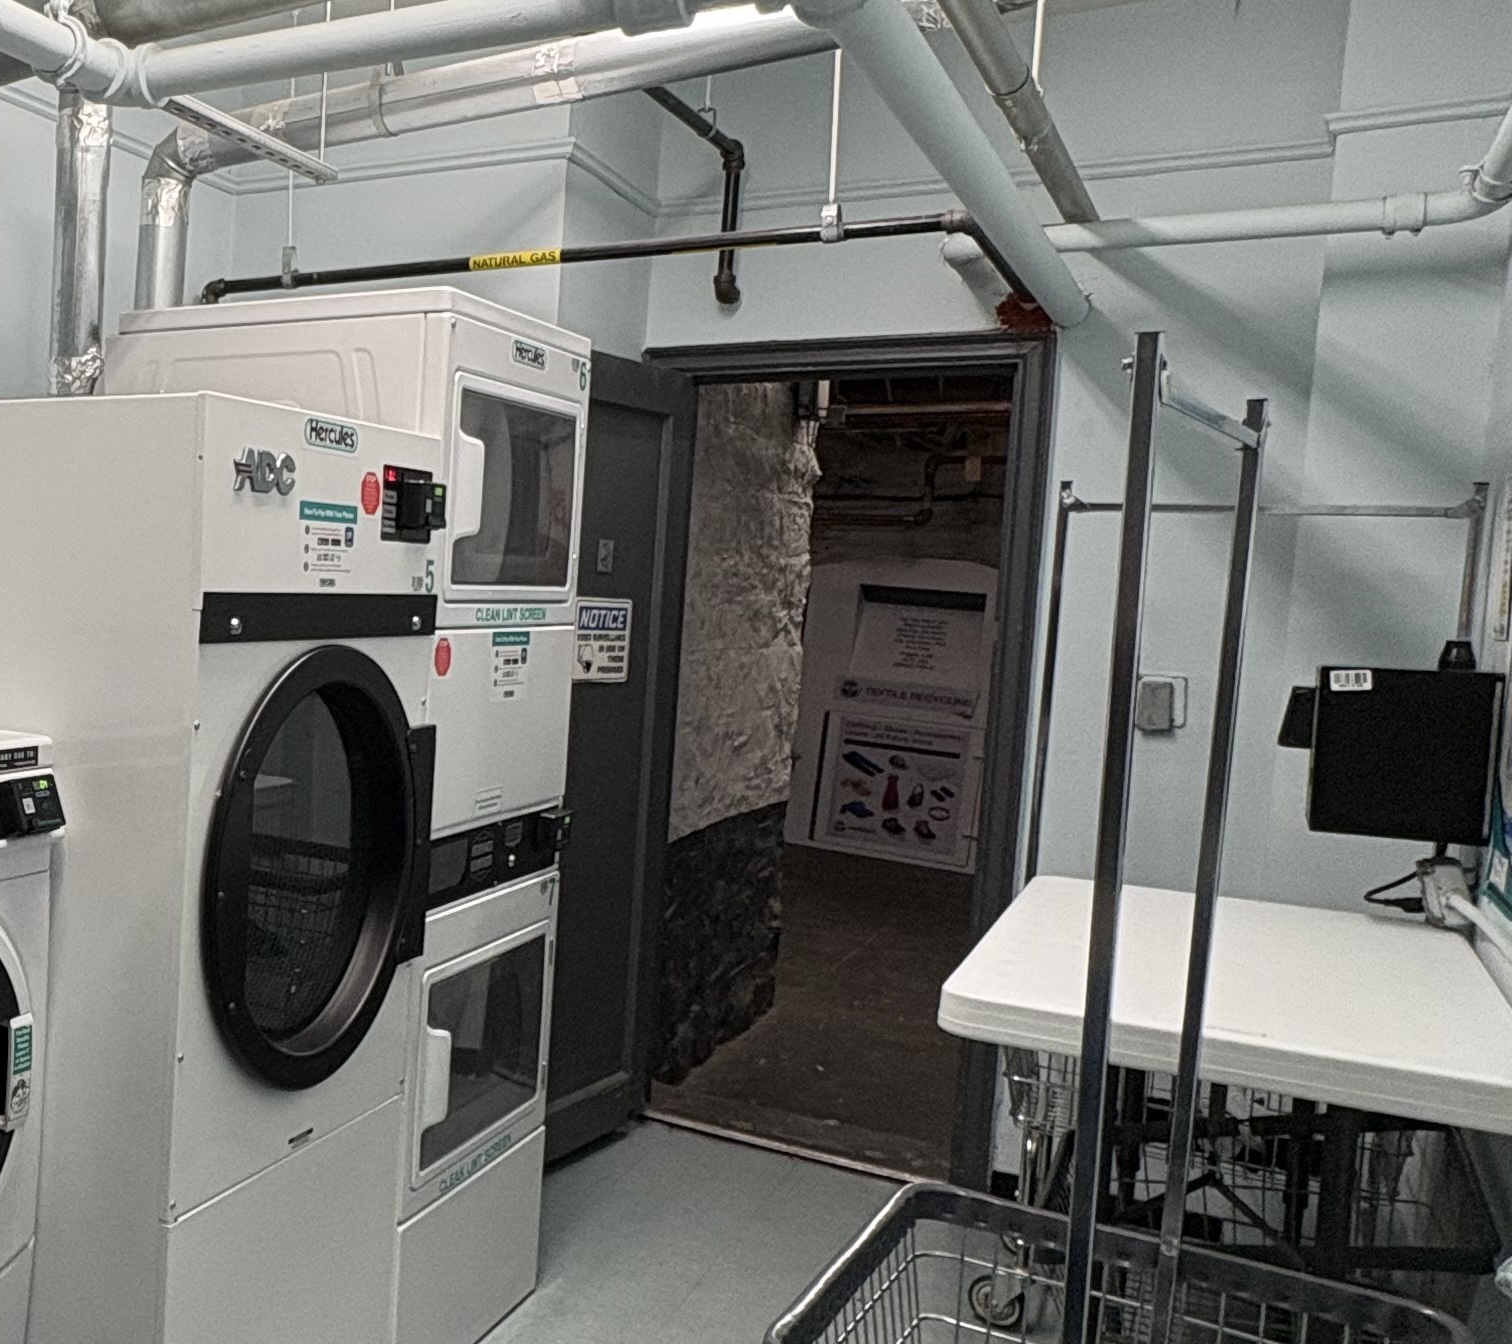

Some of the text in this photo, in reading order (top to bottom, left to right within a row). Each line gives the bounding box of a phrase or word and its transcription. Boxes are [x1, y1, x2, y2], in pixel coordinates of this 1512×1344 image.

[472, 251, 557, 269] NATURAL GAS
[514, 343, 545, 366] Hercules
[579, 361, 587, 391] 6
[309, 420, 355, 448] Hercules
[232, 446, 297, 496] ADC
[425, 560, 435, 593] 5
[475, 608, 547, 622] CLEAN LINT SCREEN
[580, 609, 627, 629] NOTICE
